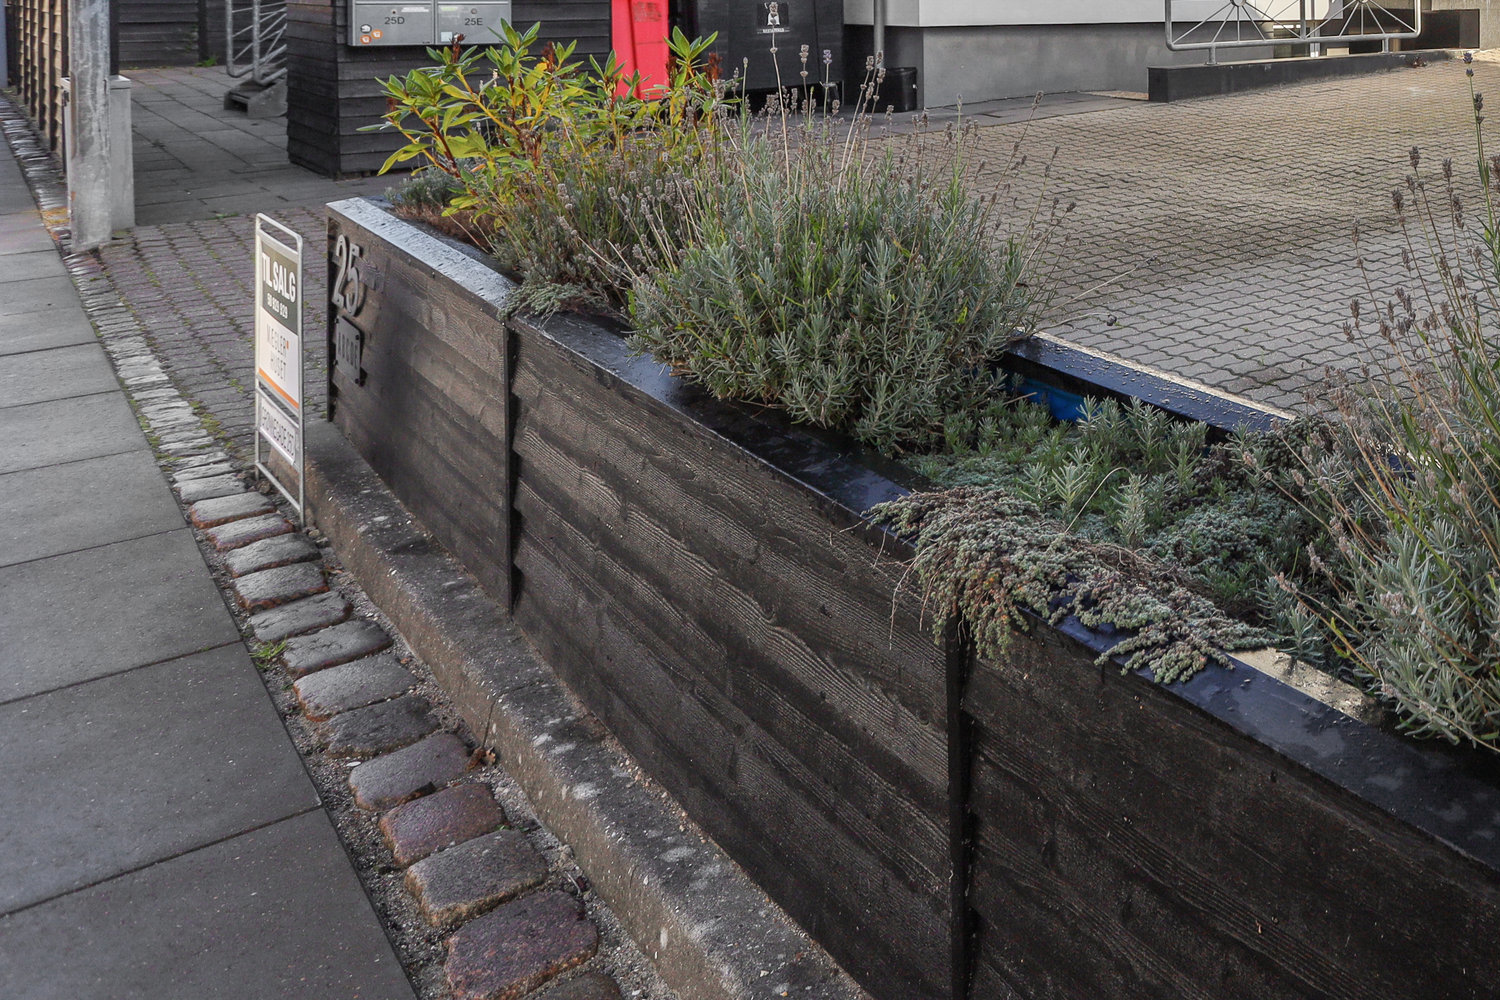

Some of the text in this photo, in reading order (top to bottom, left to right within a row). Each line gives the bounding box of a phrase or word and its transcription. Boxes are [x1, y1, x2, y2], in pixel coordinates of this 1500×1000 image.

[384, 16, 406, 25] 25D
[464, 18, 483, 26] 25E
[272, 260, 296, 303] SALG
[332, 234, 361, 318] 25
